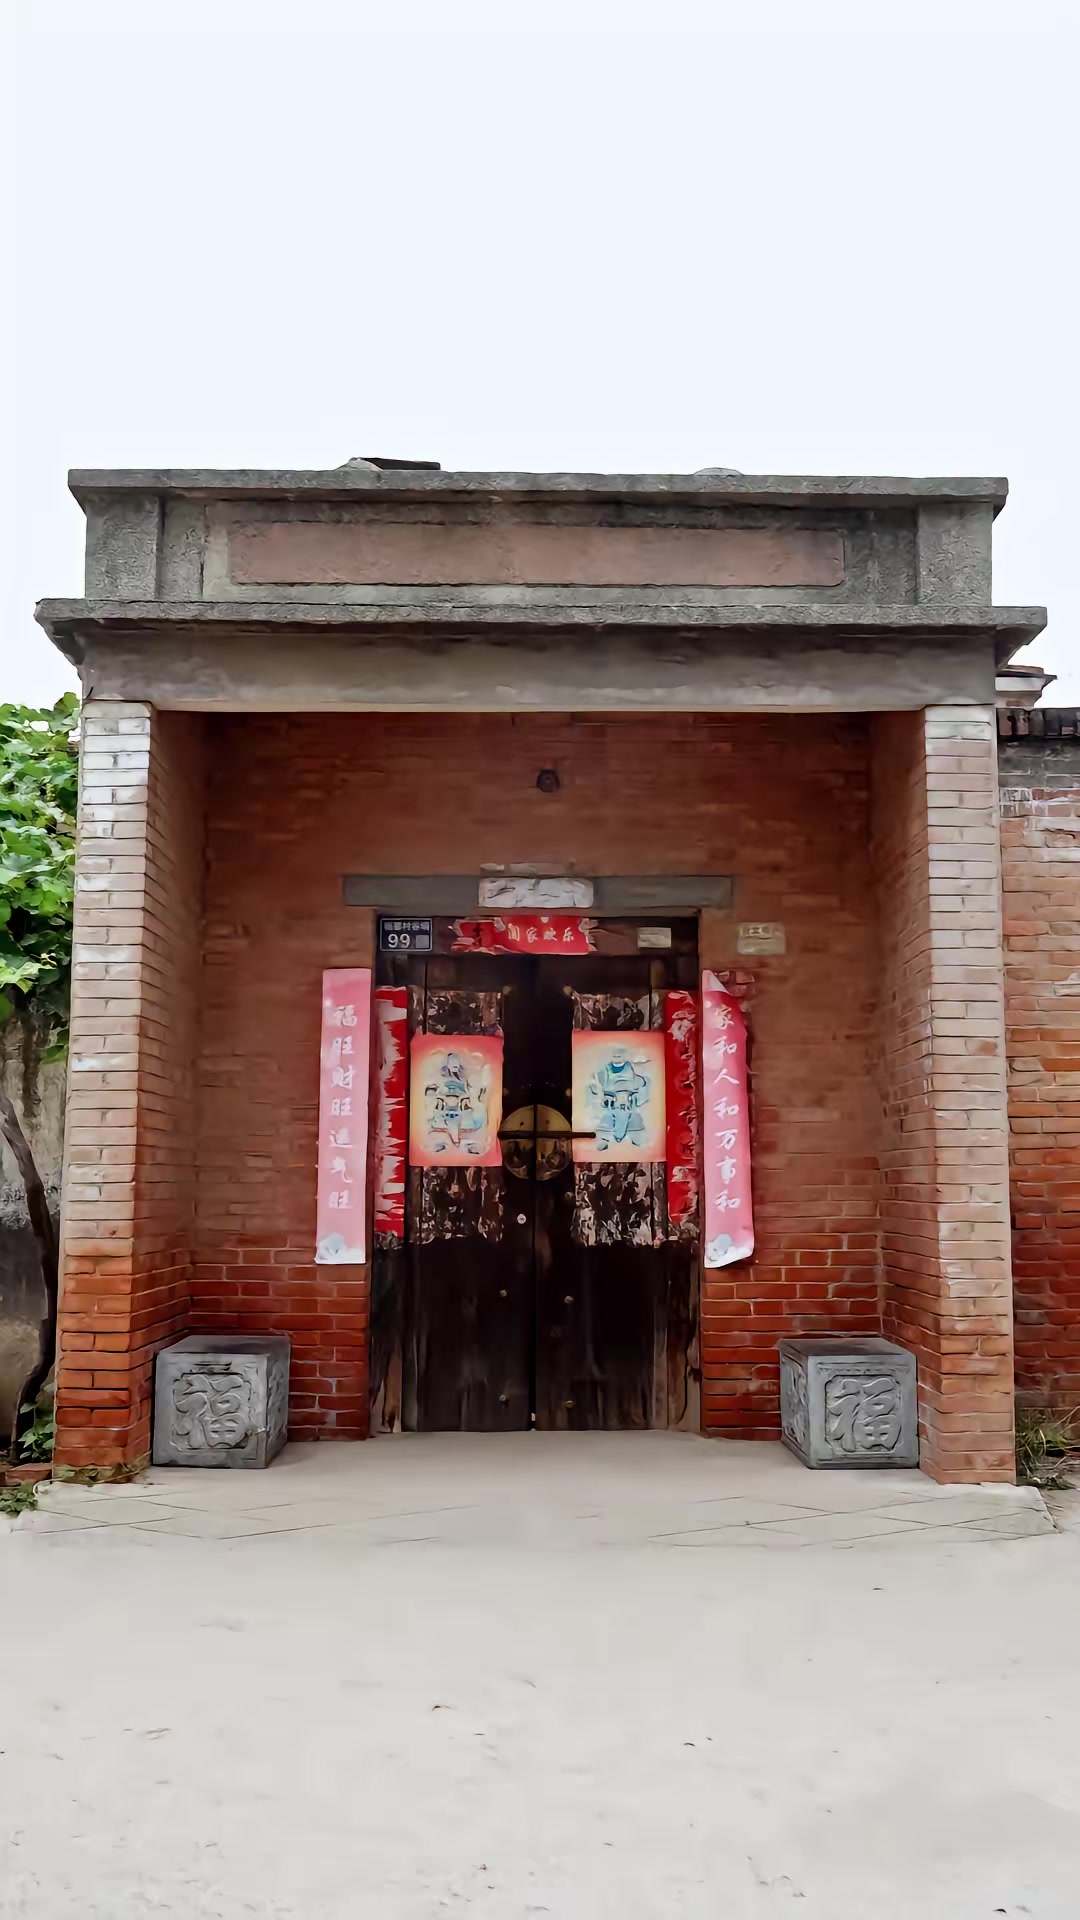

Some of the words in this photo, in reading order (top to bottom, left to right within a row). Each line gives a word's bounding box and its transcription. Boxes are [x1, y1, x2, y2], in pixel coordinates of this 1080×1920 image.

[388, 933, 410, 948] 99
[712, 1003, 741, 1212] 家和人和万事和
[828, 1377, 898, 1452] 福
